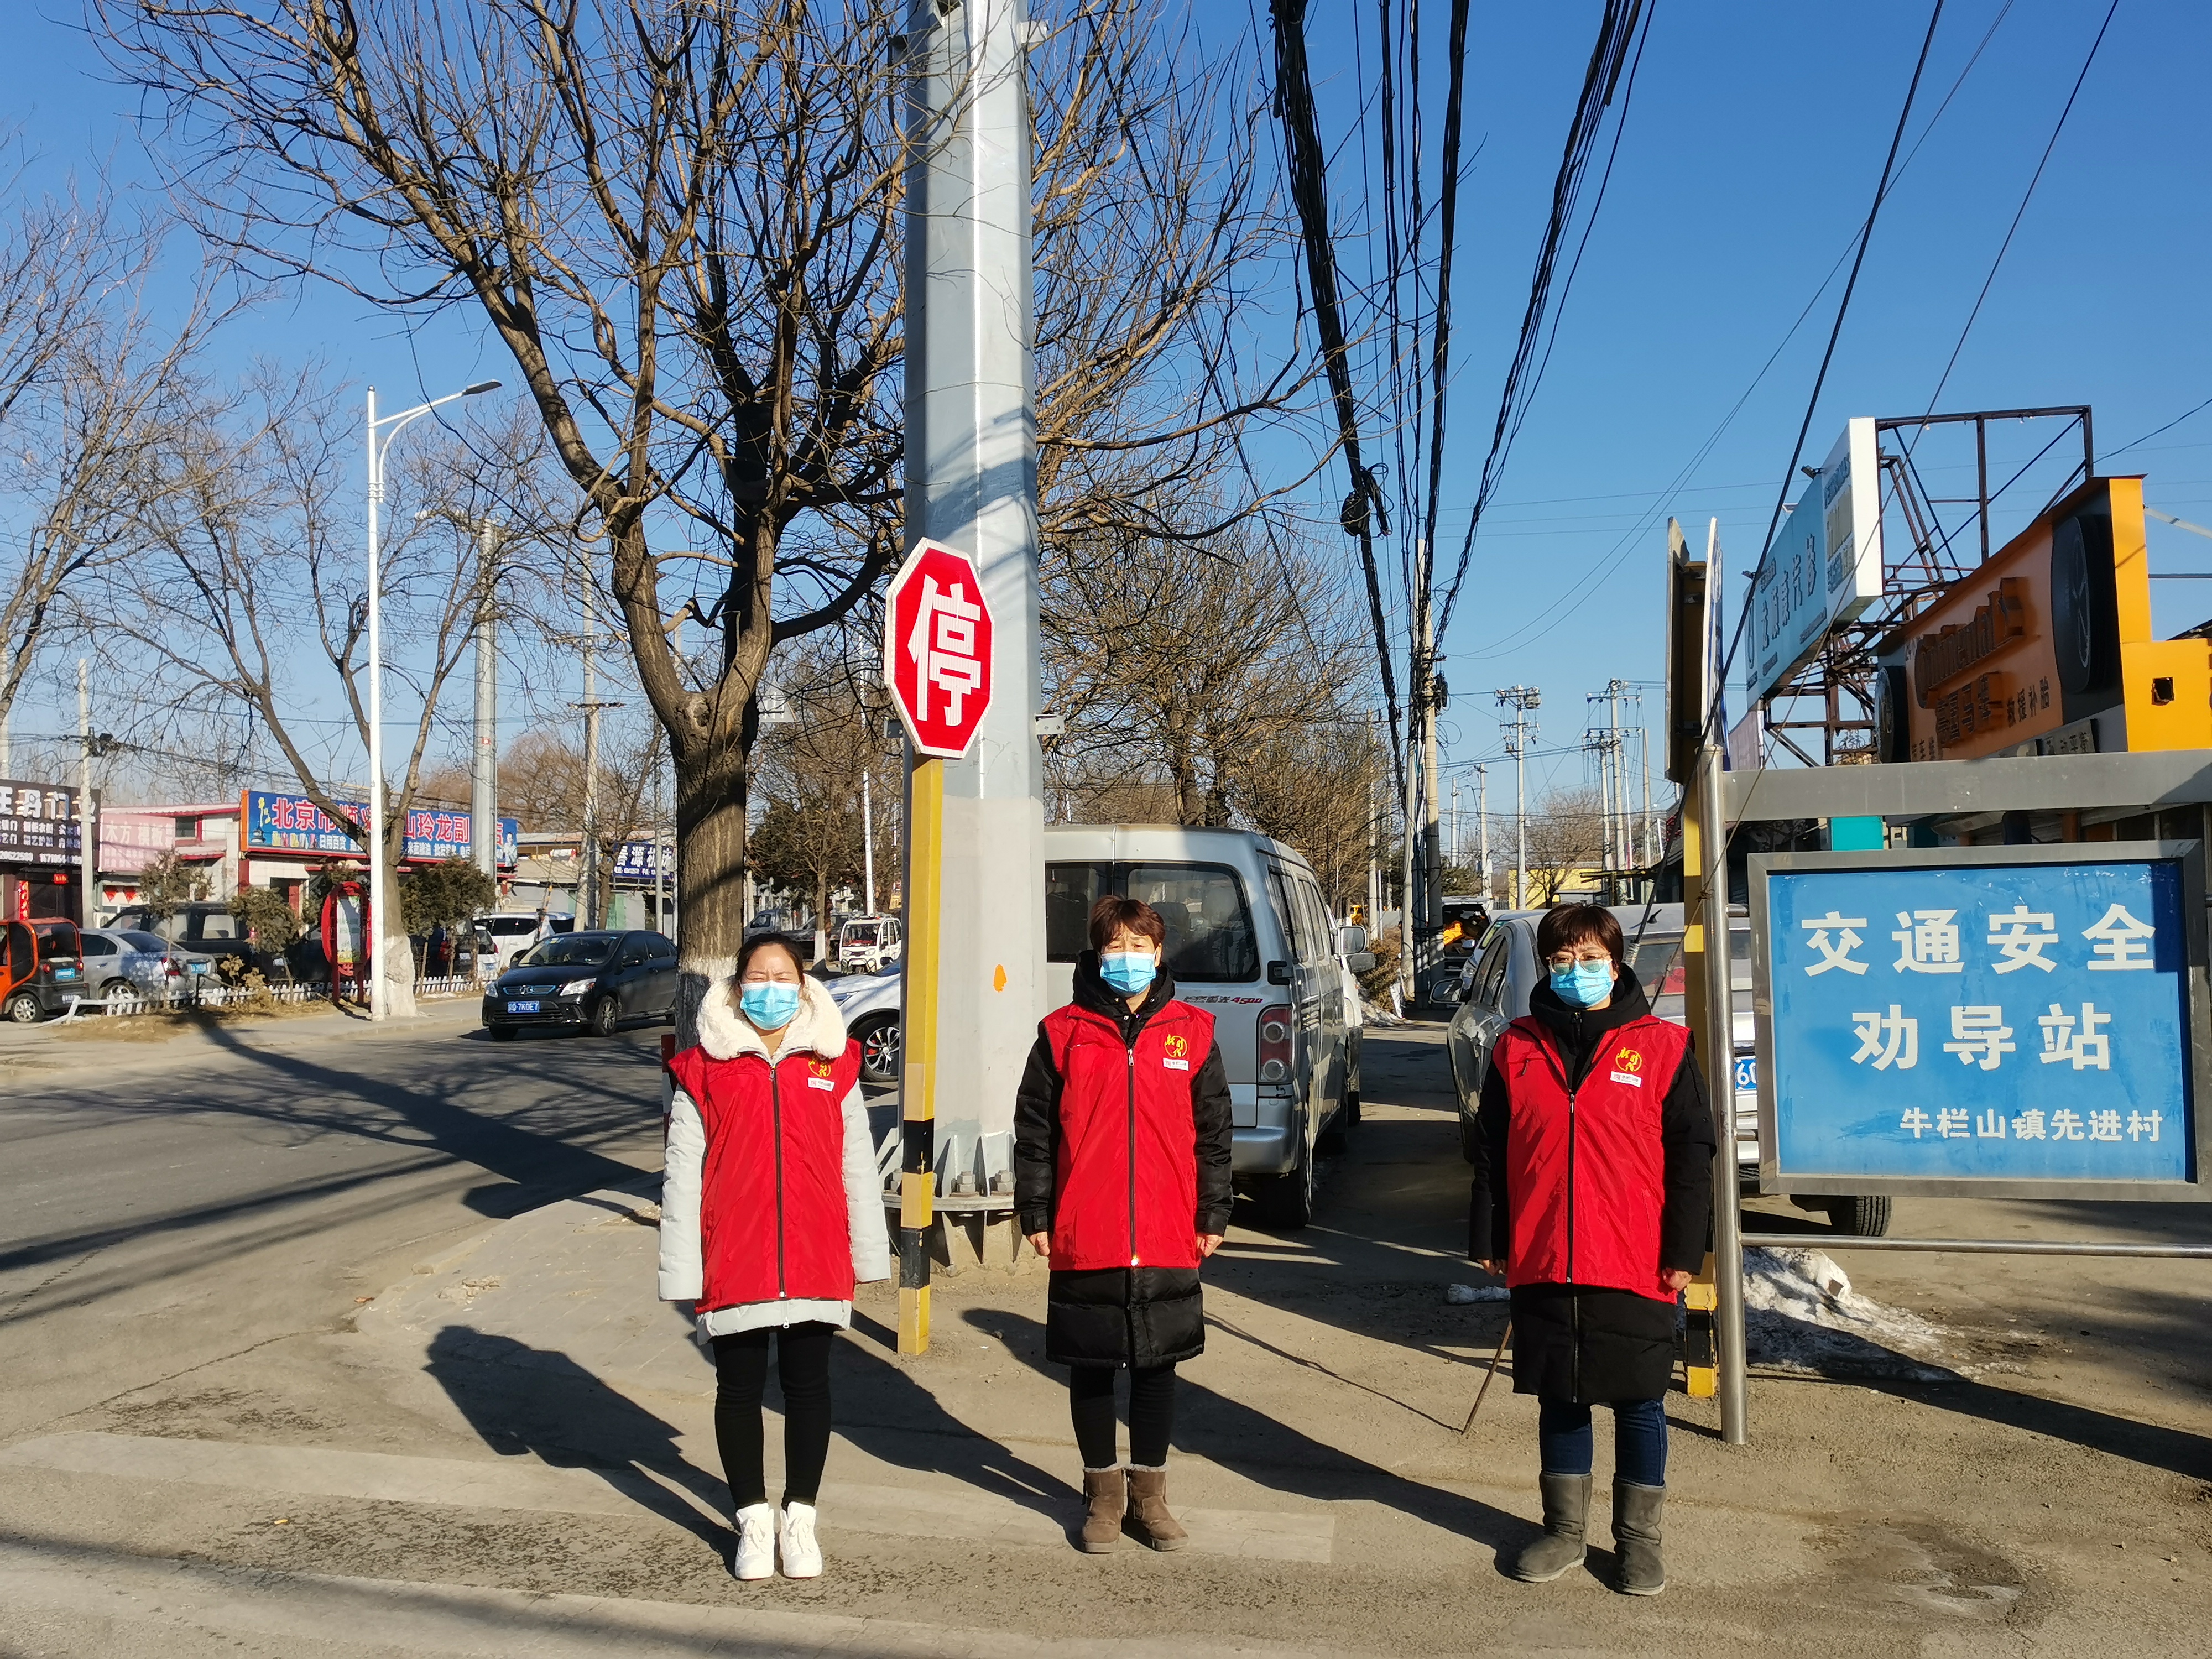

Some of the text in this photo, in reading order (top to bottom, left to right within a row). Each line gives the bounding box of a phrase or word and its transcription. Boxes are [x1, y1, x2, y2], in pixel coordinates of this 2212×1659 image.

[907, 573, 982, 726] 停
[1801, 904, 2156, 976] 交通安全
[1850, 1002, 2112, 1072] 劝导站
[1900, 1108, 2163, 1142] 牛栏山镇先进村
